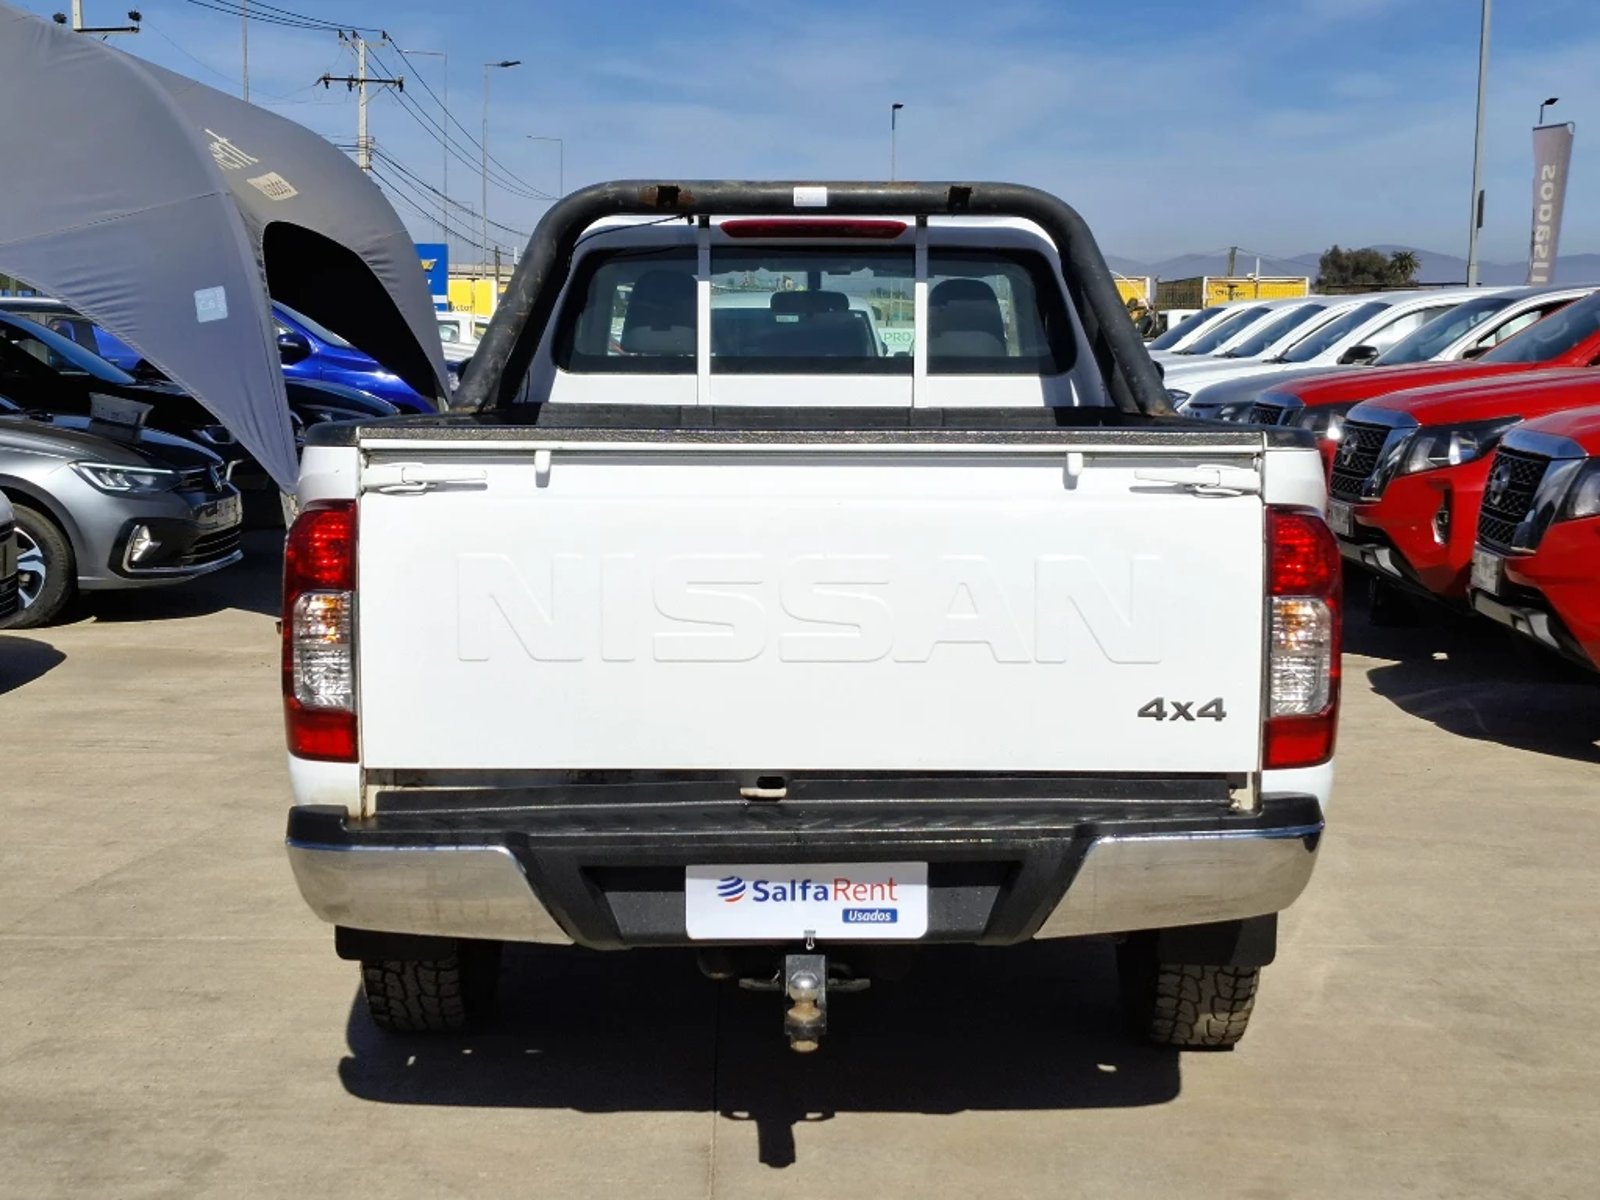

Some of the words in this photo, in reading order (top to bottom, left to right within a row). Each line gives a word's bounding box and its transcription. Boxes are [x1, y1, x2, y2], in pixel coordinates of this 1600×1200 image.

[883, 332, 911, 342] PRO
[457, 552, 1161, 663] NISSAN
[1137, 697, 1228, 722] 4x4
[848, 910, 892, 922] Usados
